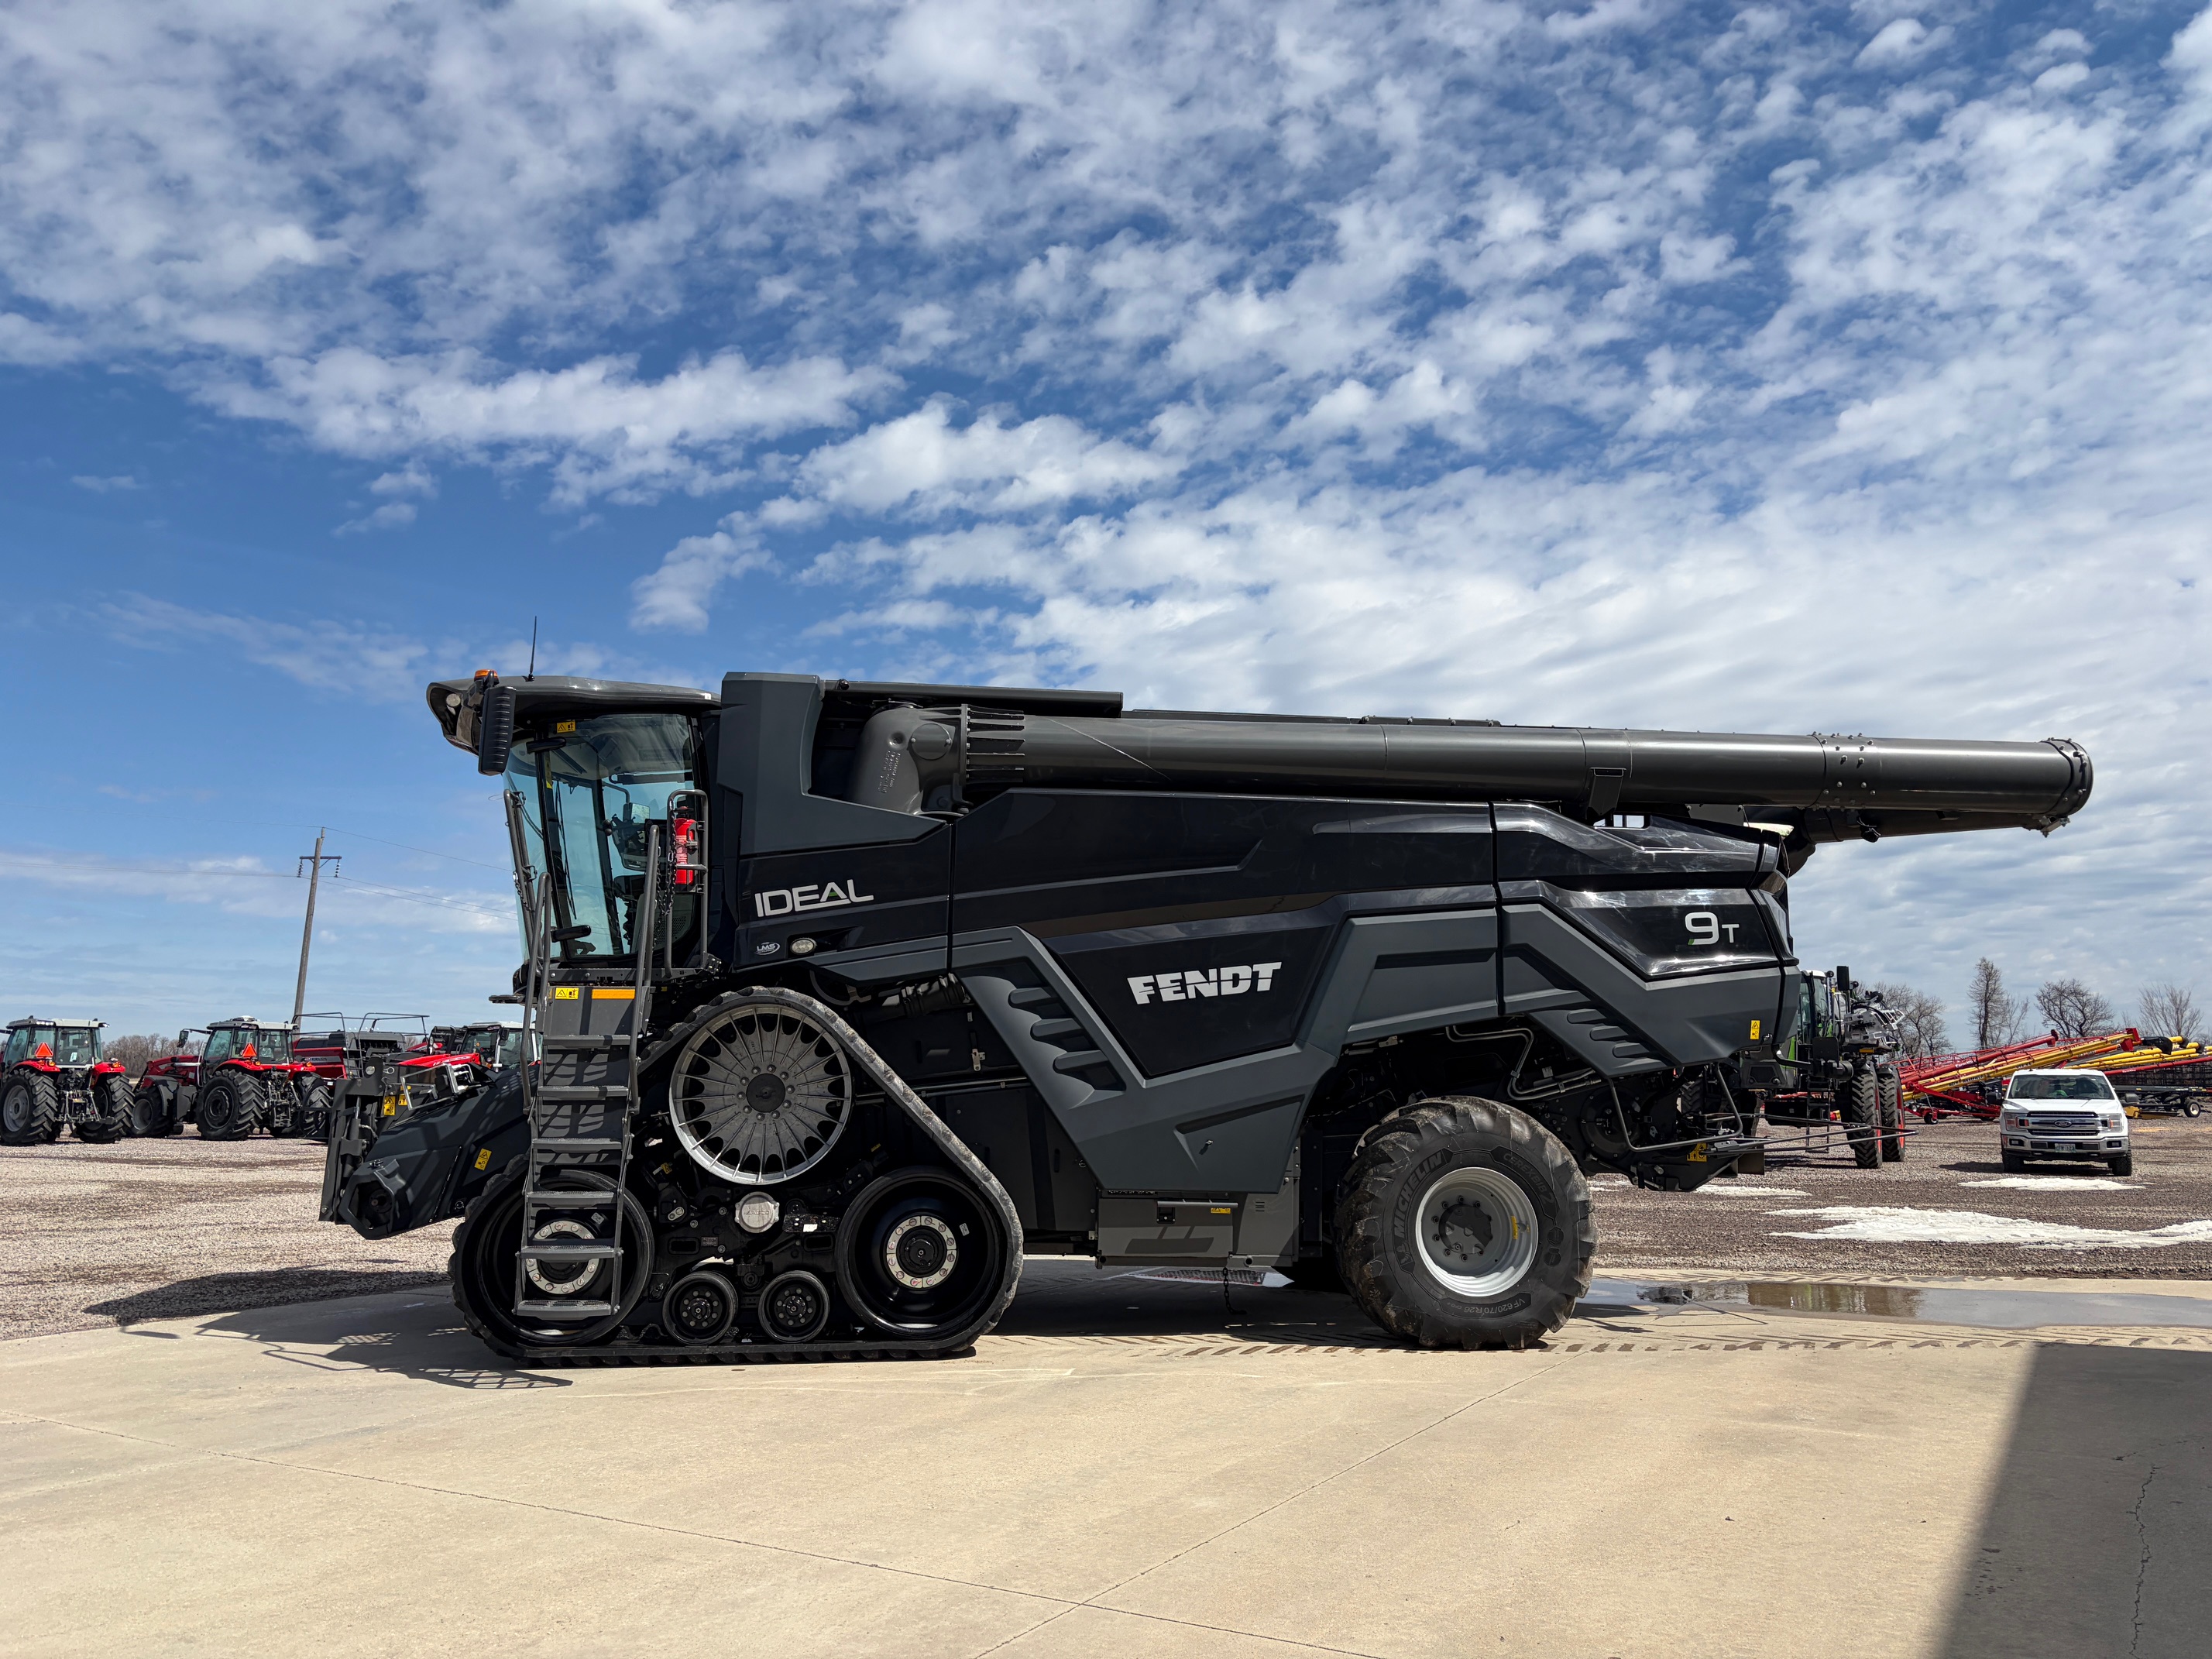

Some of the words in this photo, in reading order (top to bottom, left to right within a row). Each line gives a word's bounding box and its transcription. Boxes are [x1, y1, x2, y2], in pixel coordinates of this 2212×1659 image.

[754, 879, 874, 917] IDEAL
[1127, 961, 1282, 1005] FENDT
[1503, 1152, 1547, 1194] CEREXBIB
[1394, 1149, 1442, 1239] MICHELIN
[1485, 1304, 1513, 1314] 620/70
[1514, 1298, 1526, 1308] VF
